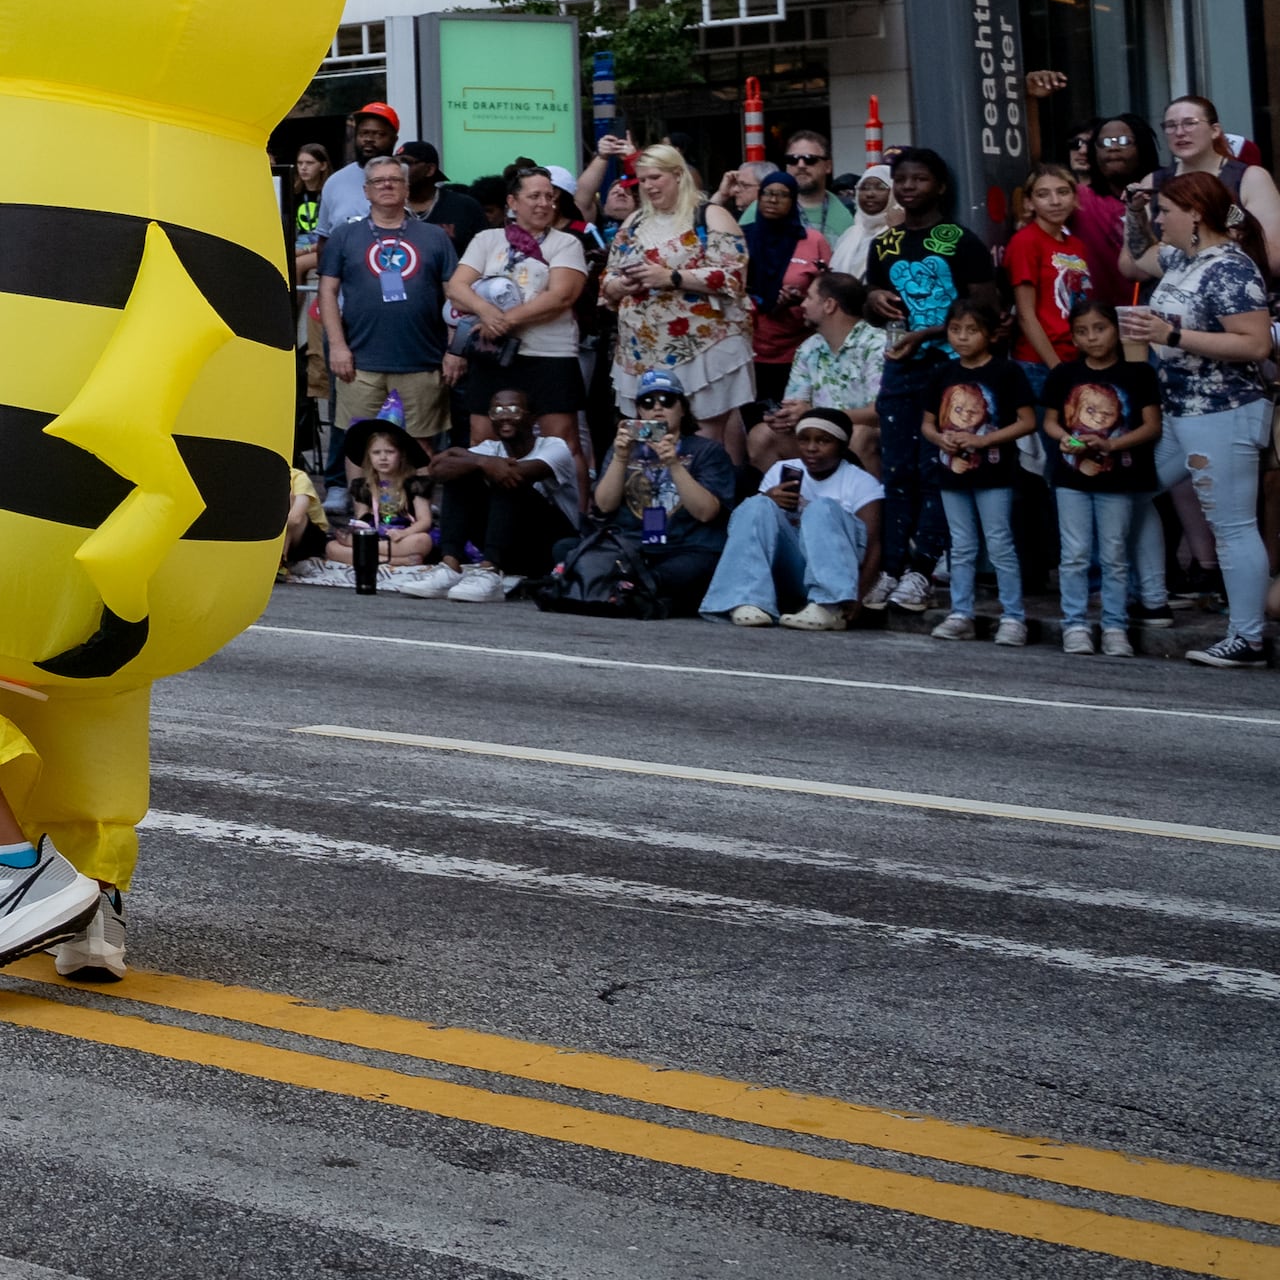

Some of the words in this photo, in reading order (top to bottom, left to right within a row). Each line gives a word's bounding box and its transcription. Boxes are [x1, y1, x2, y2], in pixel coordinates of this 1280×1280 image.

[447, 100, 468, 110] THE
[472, 101, 531, 111] DRAFTING
[535, 102, 569, 112] TABLE
[1000, 15, 1022, 157] Center
